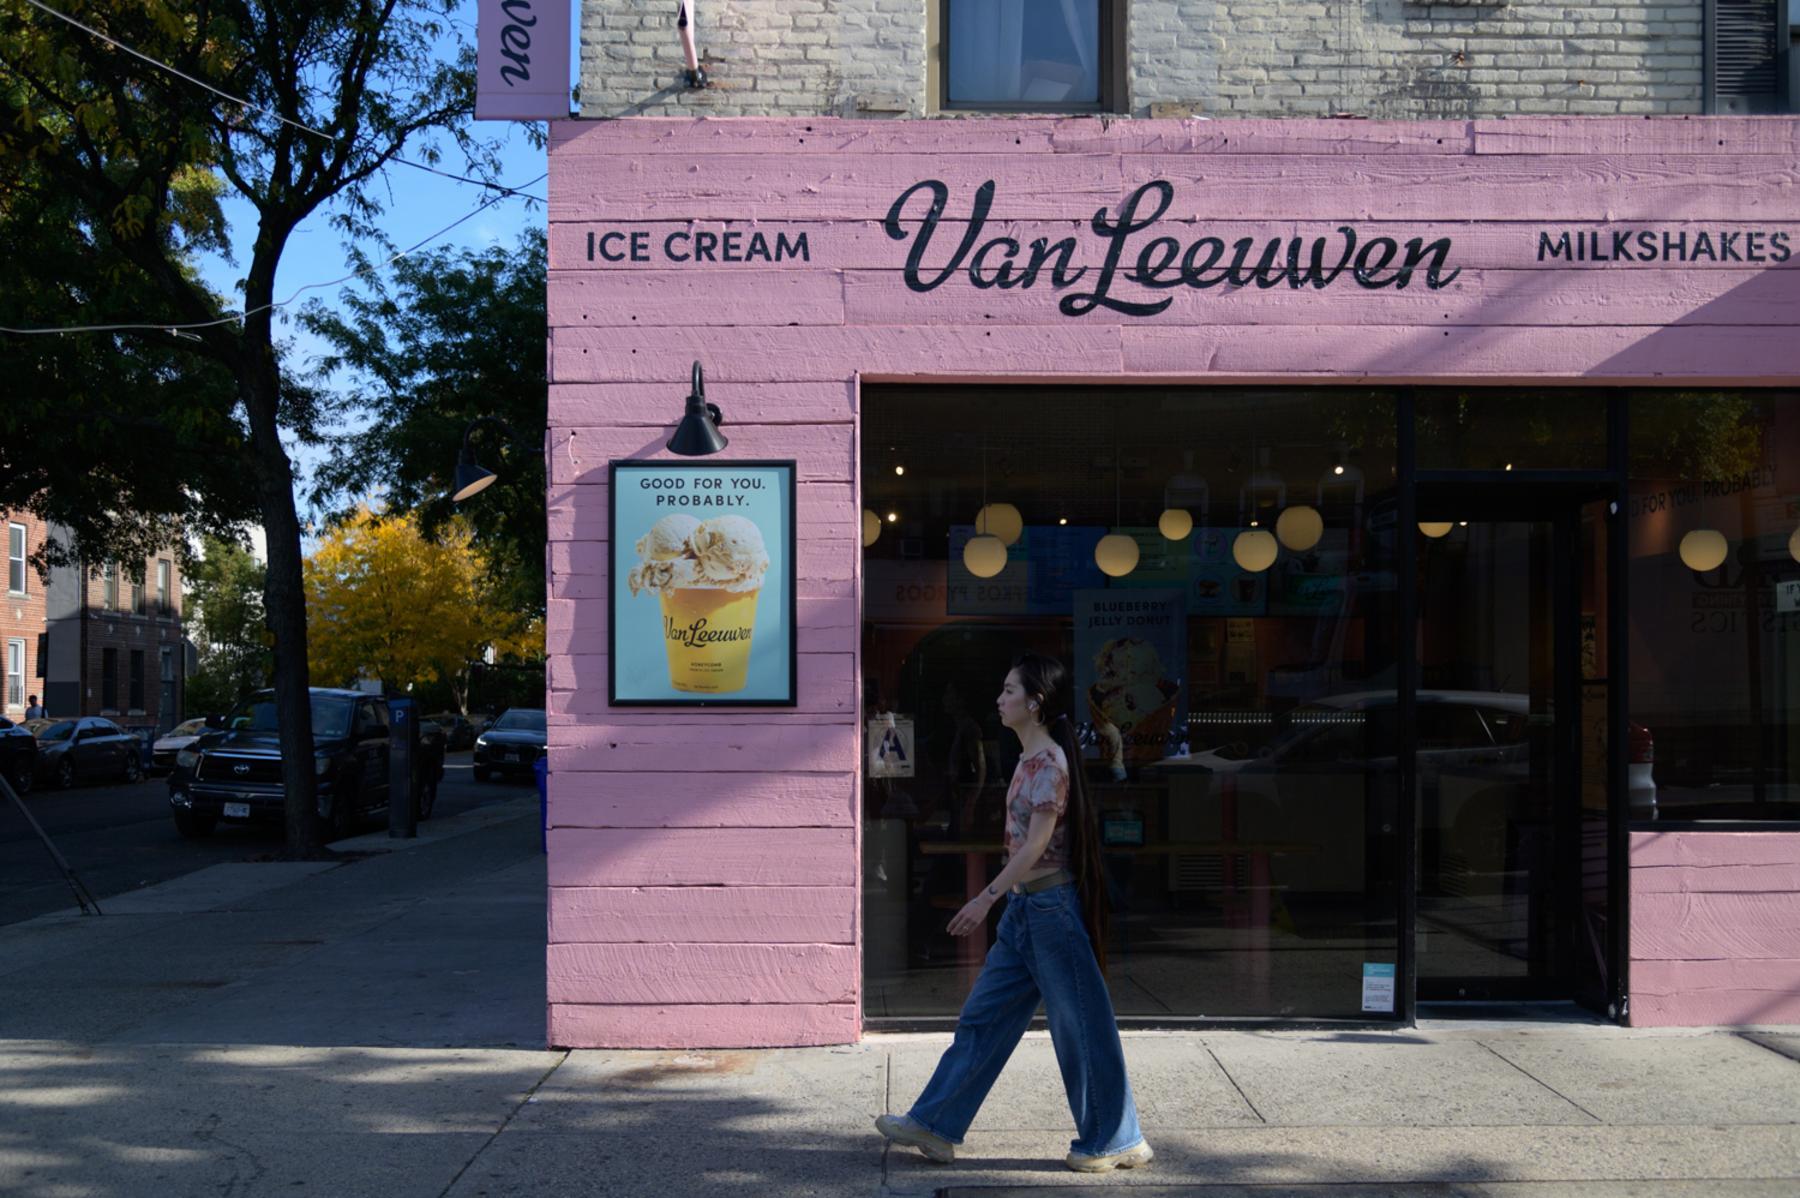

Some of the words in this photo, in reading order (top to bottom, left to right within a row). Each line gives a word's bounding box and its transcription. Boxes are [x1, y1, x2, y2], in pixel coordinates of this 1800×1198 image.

[587, 231, 650, 262] ICE
[664, 231, 810, 262] CREAM
[1537, 230, 1791, 262] MILKSHAKES
[640, 478, 685, 489] GOOD
[694, 478, 722, 489] FOR
[730, 478, 766, 489] YOU.
[656, 495, 750, 506] PROBABLY.
[1642, 492, 1665, 514] FOR
[1093, 602, 1167, 612] BLUEBERRY
[1088, 616, 1121, 628] JELLY
[1127, 616, 1170, 625] DONUT
[395, 709, 405, 722] P
[879, 727, 906, 761] A
